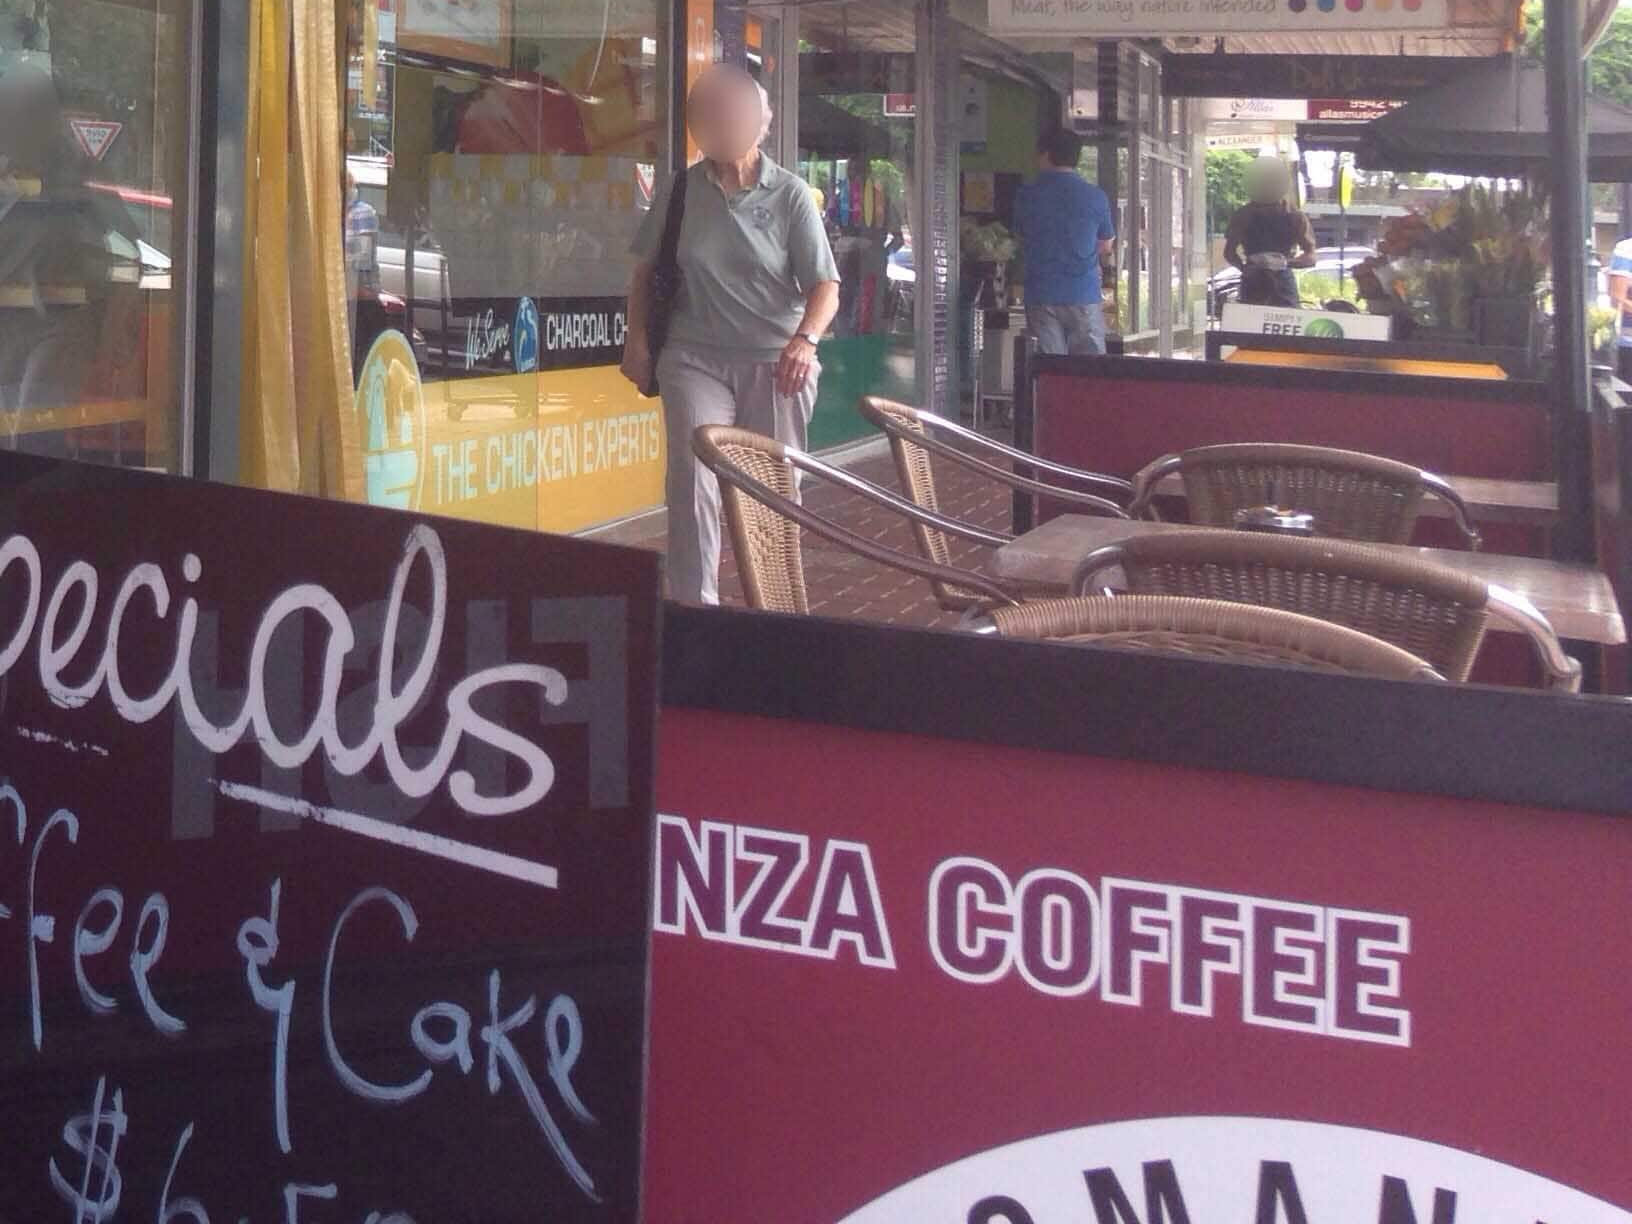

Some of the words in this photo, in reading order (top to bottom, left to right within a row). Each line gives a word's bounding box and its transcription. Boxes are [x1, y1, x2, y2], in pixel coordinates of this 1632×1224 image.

[1096, 0, 1135, 23] way
[546, 313, 611, 351] CHARCOAL
[432, 438, 478, 506] THE
[485, 423, 578, 495] CHICKEN
[582, 410, 660, 475] EXPERTS
[653, 814, 896, 968] NZA
[929, 856, 1411, 1048] COFFEE
[321, 887, 602, 1203] Cake
